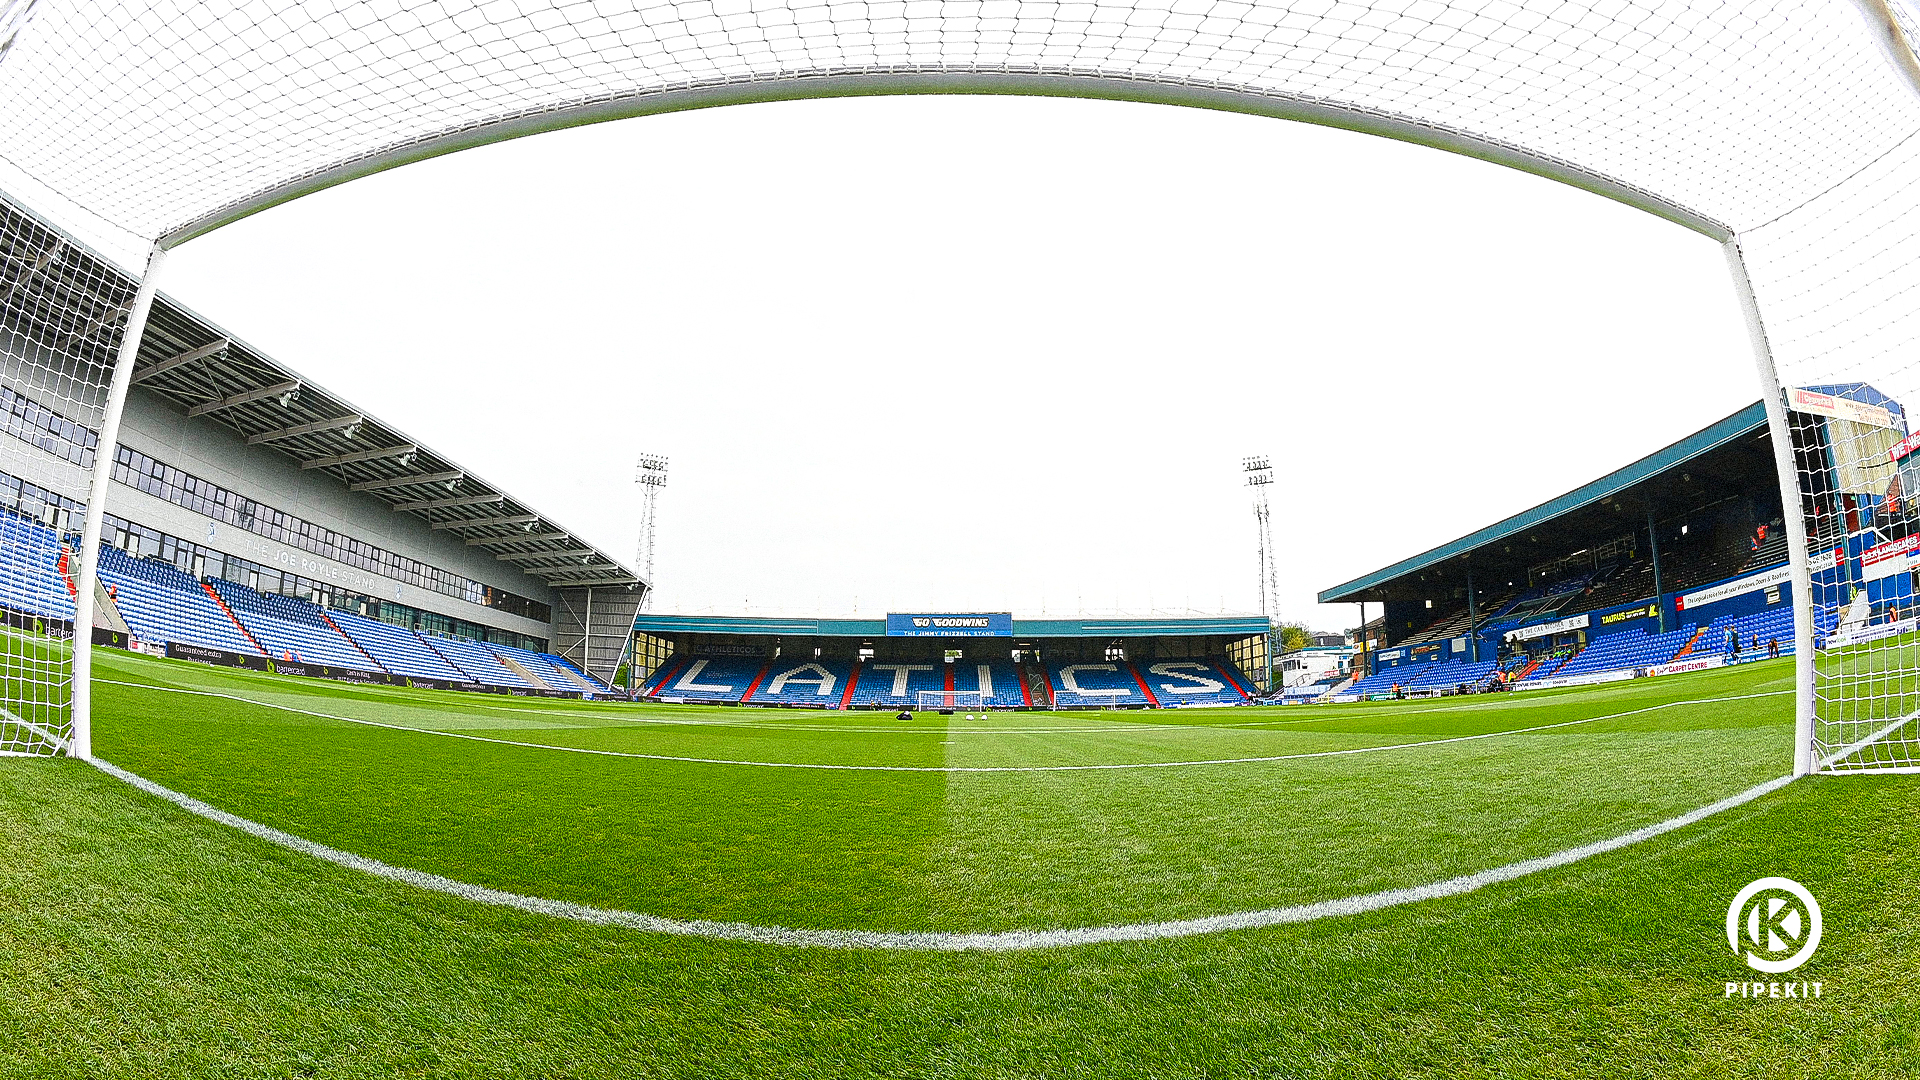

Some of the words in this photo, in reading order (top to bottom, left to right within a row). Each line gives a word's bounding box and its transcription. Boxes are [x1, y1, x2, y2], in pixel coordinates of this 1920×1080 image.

[246, 540, 268, 559] THE
[274, 552, 296, 566] JOE
[301, 560, 338, 578] ROYLE
[342, 571, 375, 590] STAND
[912, 617, 930, 627] GO
[932, 617, 989, 628] GOODWINS
[1602, 612, 1626, 624] TAURUS
[176, 644, 208, 656] Guaranteed
[276, 664, 306, 676] bartercard
[1668, 664, 1687, 673] CARPET
[1688, 661, 1708, 671] CENTRE
[674, 659, 1226, 699] LATICS
